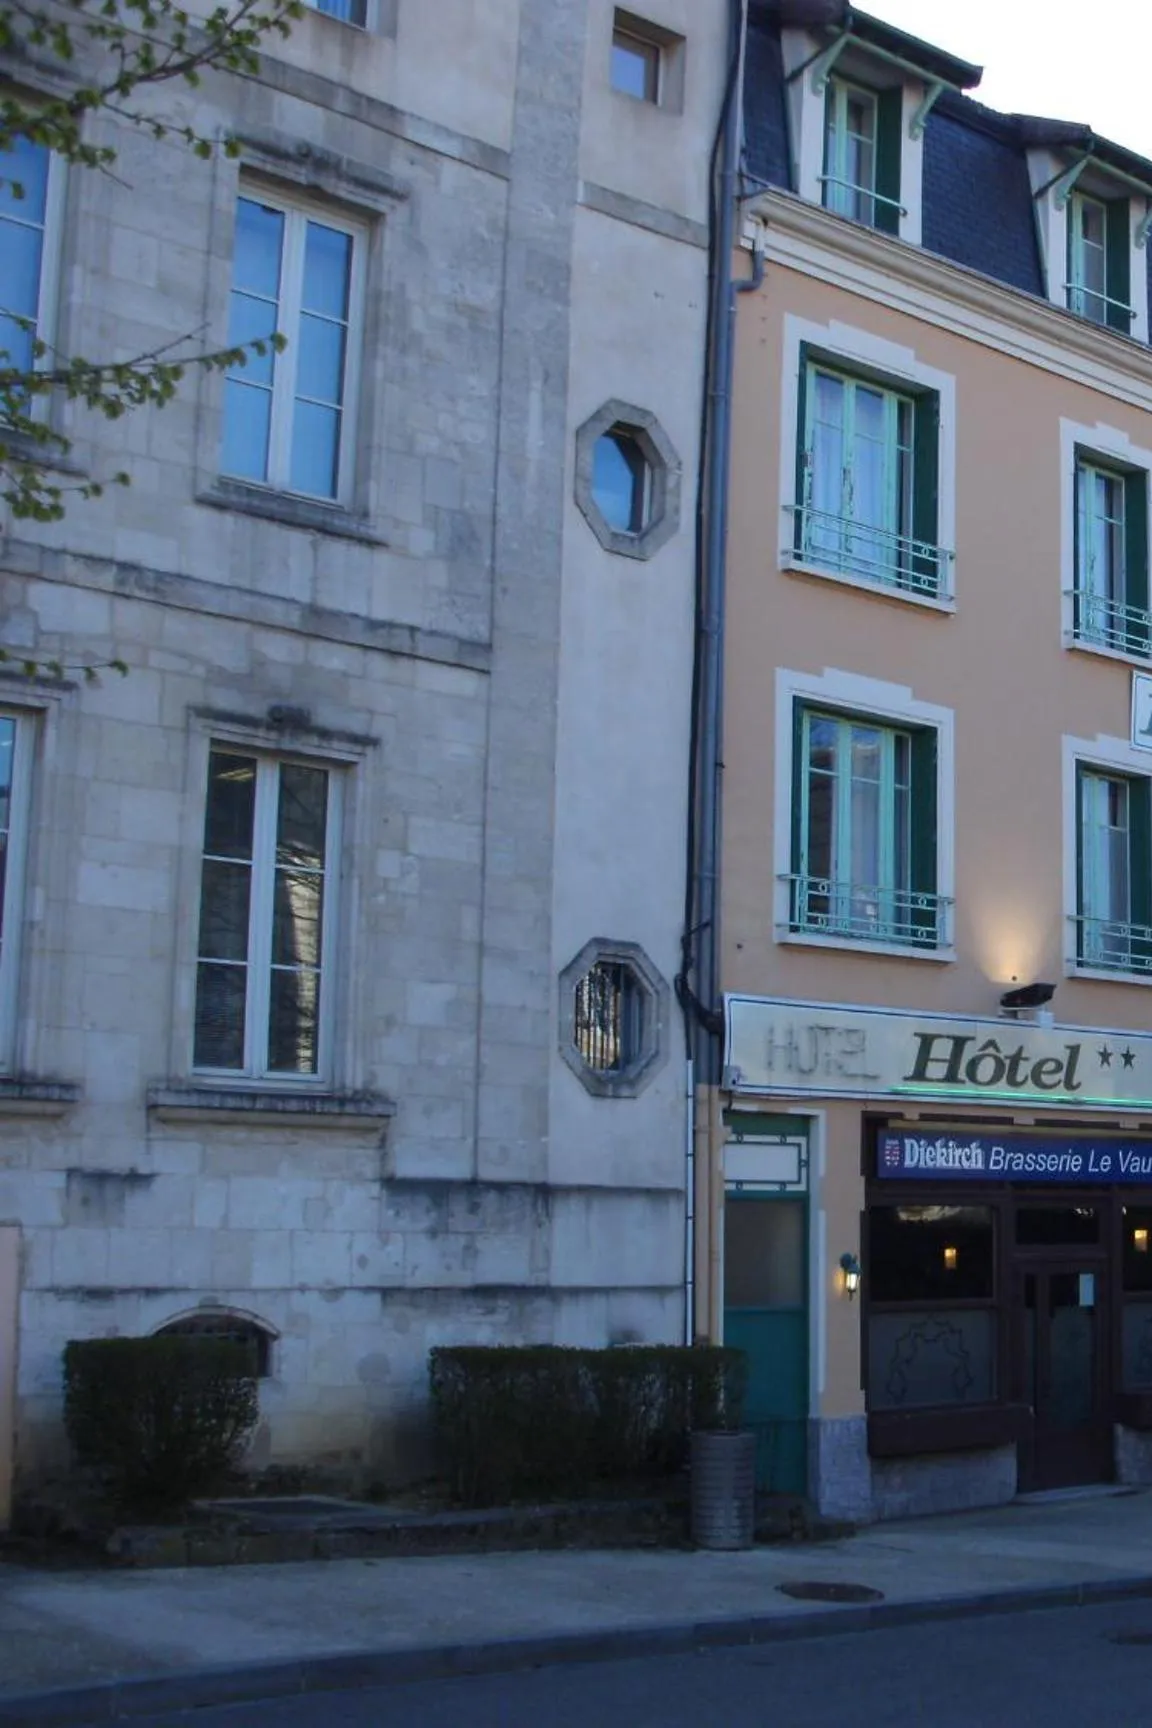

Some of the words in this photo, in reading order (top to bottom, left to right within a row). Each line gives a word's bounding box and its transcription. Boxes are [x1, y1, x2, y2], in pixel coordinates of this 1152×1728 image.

[903, 1032, 1082, 1091] Hôtel
[904, 1138, 984, 1169] Diekirch
[989, 1147, 1082, 1172] Brasserie
[1088, 1150, 1112, 1172] Le
